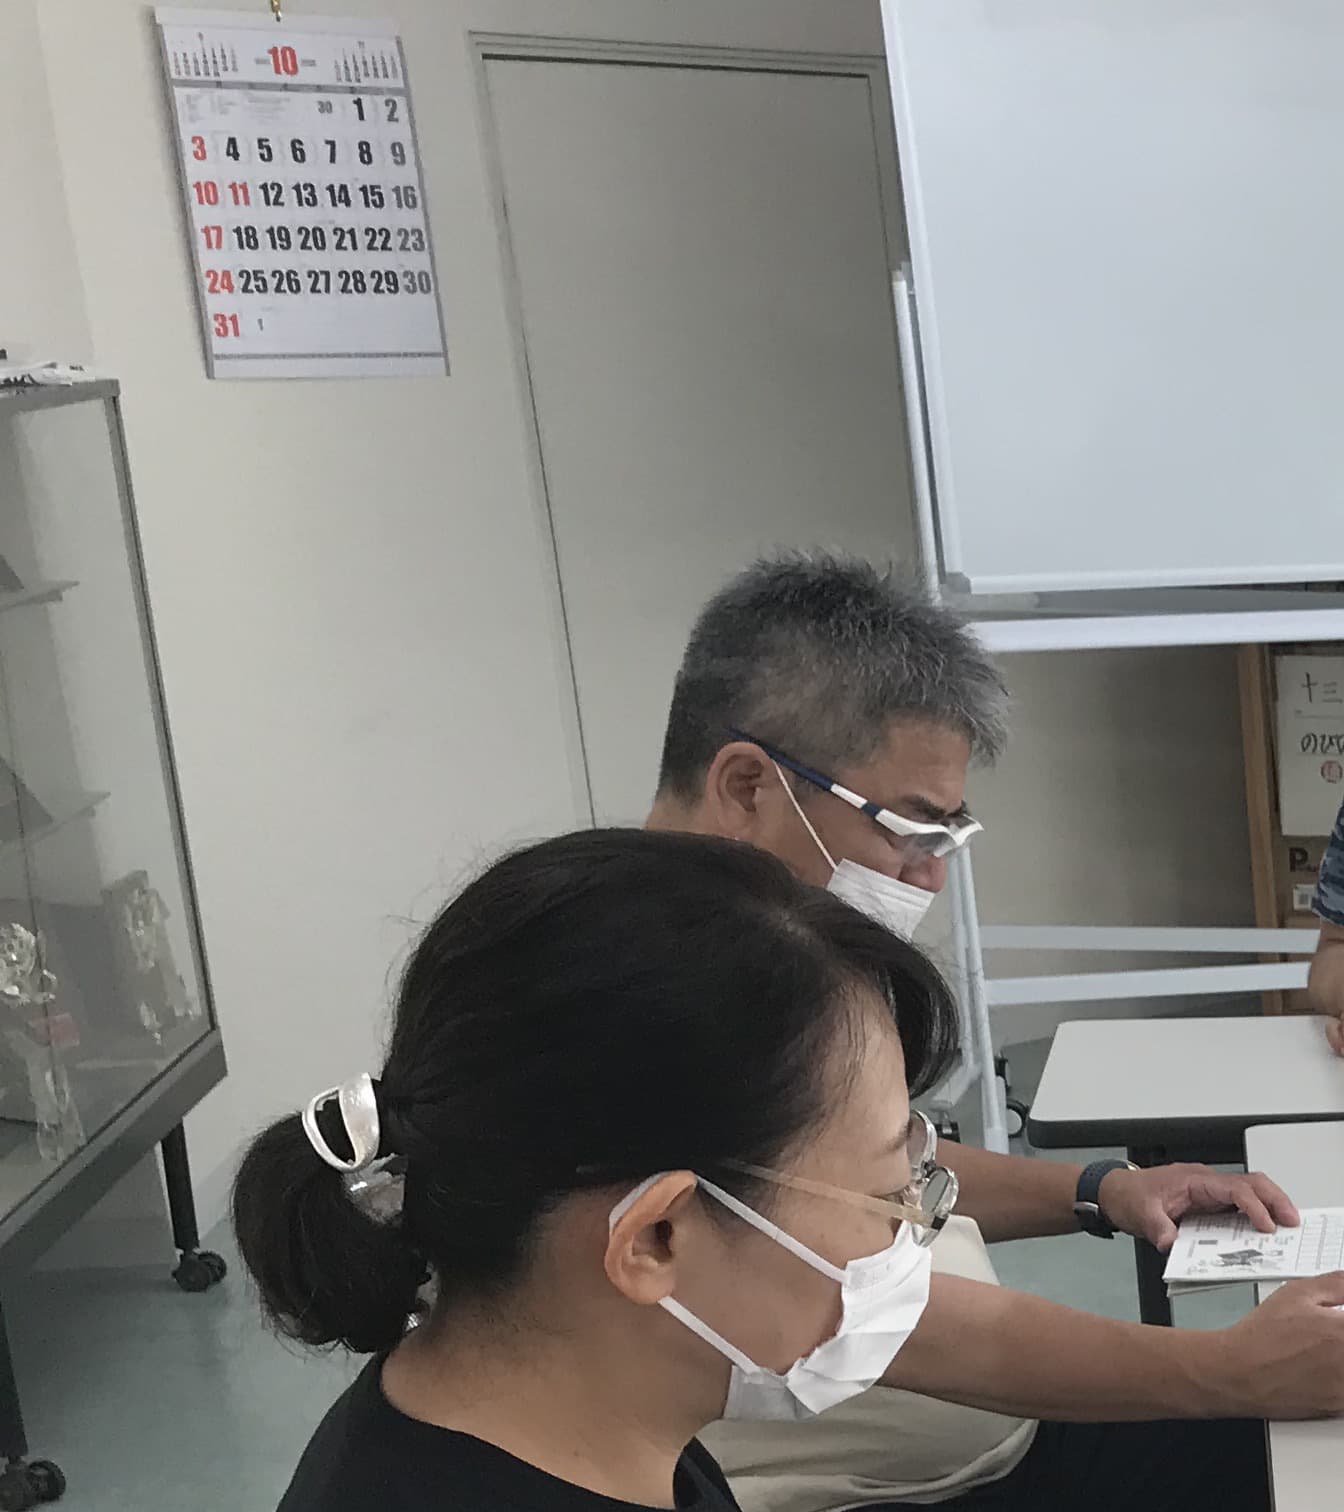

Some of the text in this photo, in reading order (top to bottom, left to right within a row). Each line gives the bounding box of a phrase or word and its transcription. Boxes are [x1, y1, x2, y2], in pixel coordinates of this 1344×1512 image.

[267, 46, 299, 76] 10
[353, 98, 365, 121] 1
[385, 100, 399, 122] 2
[191, 136, 406, 165] 3 4 5 6 7 8 9
[192, 182, 417, 209] 10 11 12 13 14 15 16
[201, 226, 425, 251] 17 18 19 20 21 22 23
[205, 270, 432, 294] 24 25 26 27 28 29 30
[213, 314, 240, 337] 31
